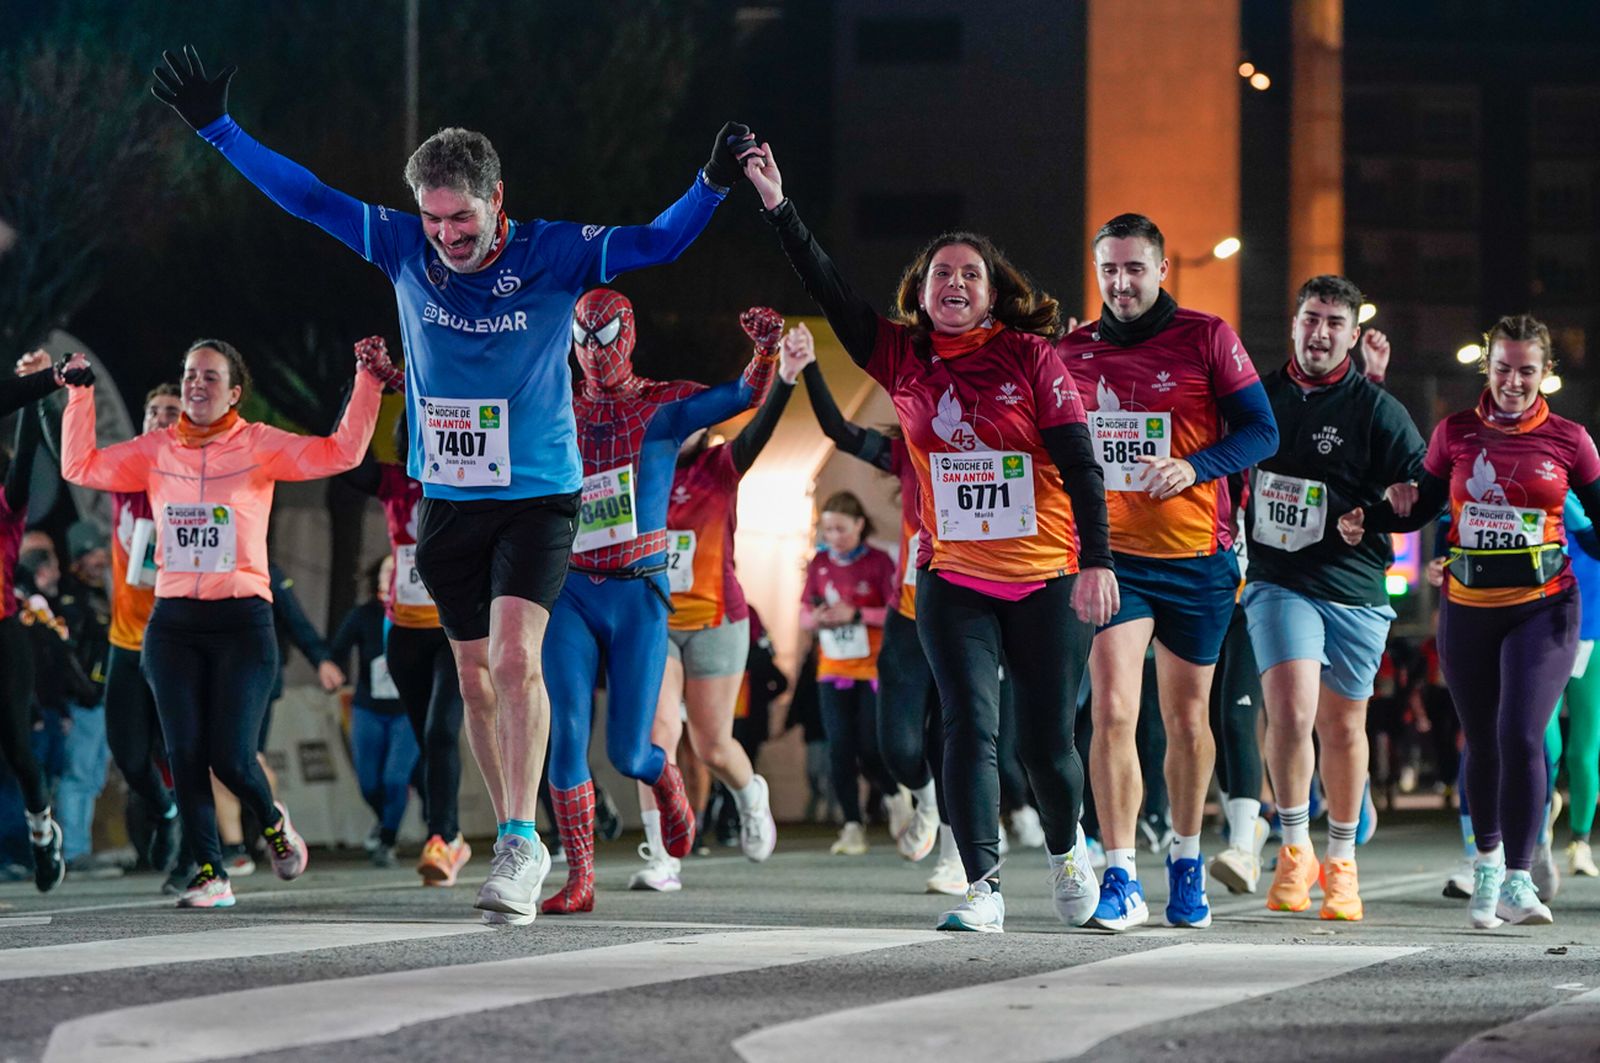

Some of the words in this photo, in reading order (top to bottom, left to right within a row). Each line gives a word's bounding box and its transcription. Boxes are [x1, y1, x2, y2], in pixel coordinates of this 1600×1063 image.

[423, 305, 437, 320] CD
[438, 308, 528, 333] BULEVAR
[435, 408, 459, 418] NOCHE
[460, 410, 470, 418] DE
[428, 418, 441, 428] SAN
[443, 419, 471, 430] ANTÓN
[1105, 421, 1127, 429] NOCHE
[1129, 421, 1138, 429] DE
[1323, 426, 1338, 434] NEW
[951, 428, 975, 451] 43
[1097, 431, 1111, 439] SAN
[1113, 430, 1139, 439] ANTÓN
[1312, 432, 1344, 446] BALANCE
[435, 430, 487, 457] 7407
[1103, 441, 1156, 464] 5859
[952, 462, 980, 471] NOCHE
[982, 461, 994, 470] DE
[942, 473, 960, 483] SAN
[963, 471, 995, 482] ANTÓN
[957, 482, 1010, 510] 6771
[580, 493, 631, 525] 8409
[1267, 500, 1309, 528] 1681
[1480, 511, 1504, 520] NOCHE
[1468, 519, 1485, 527] SAN
[176, 527, 219, 548] 6413
